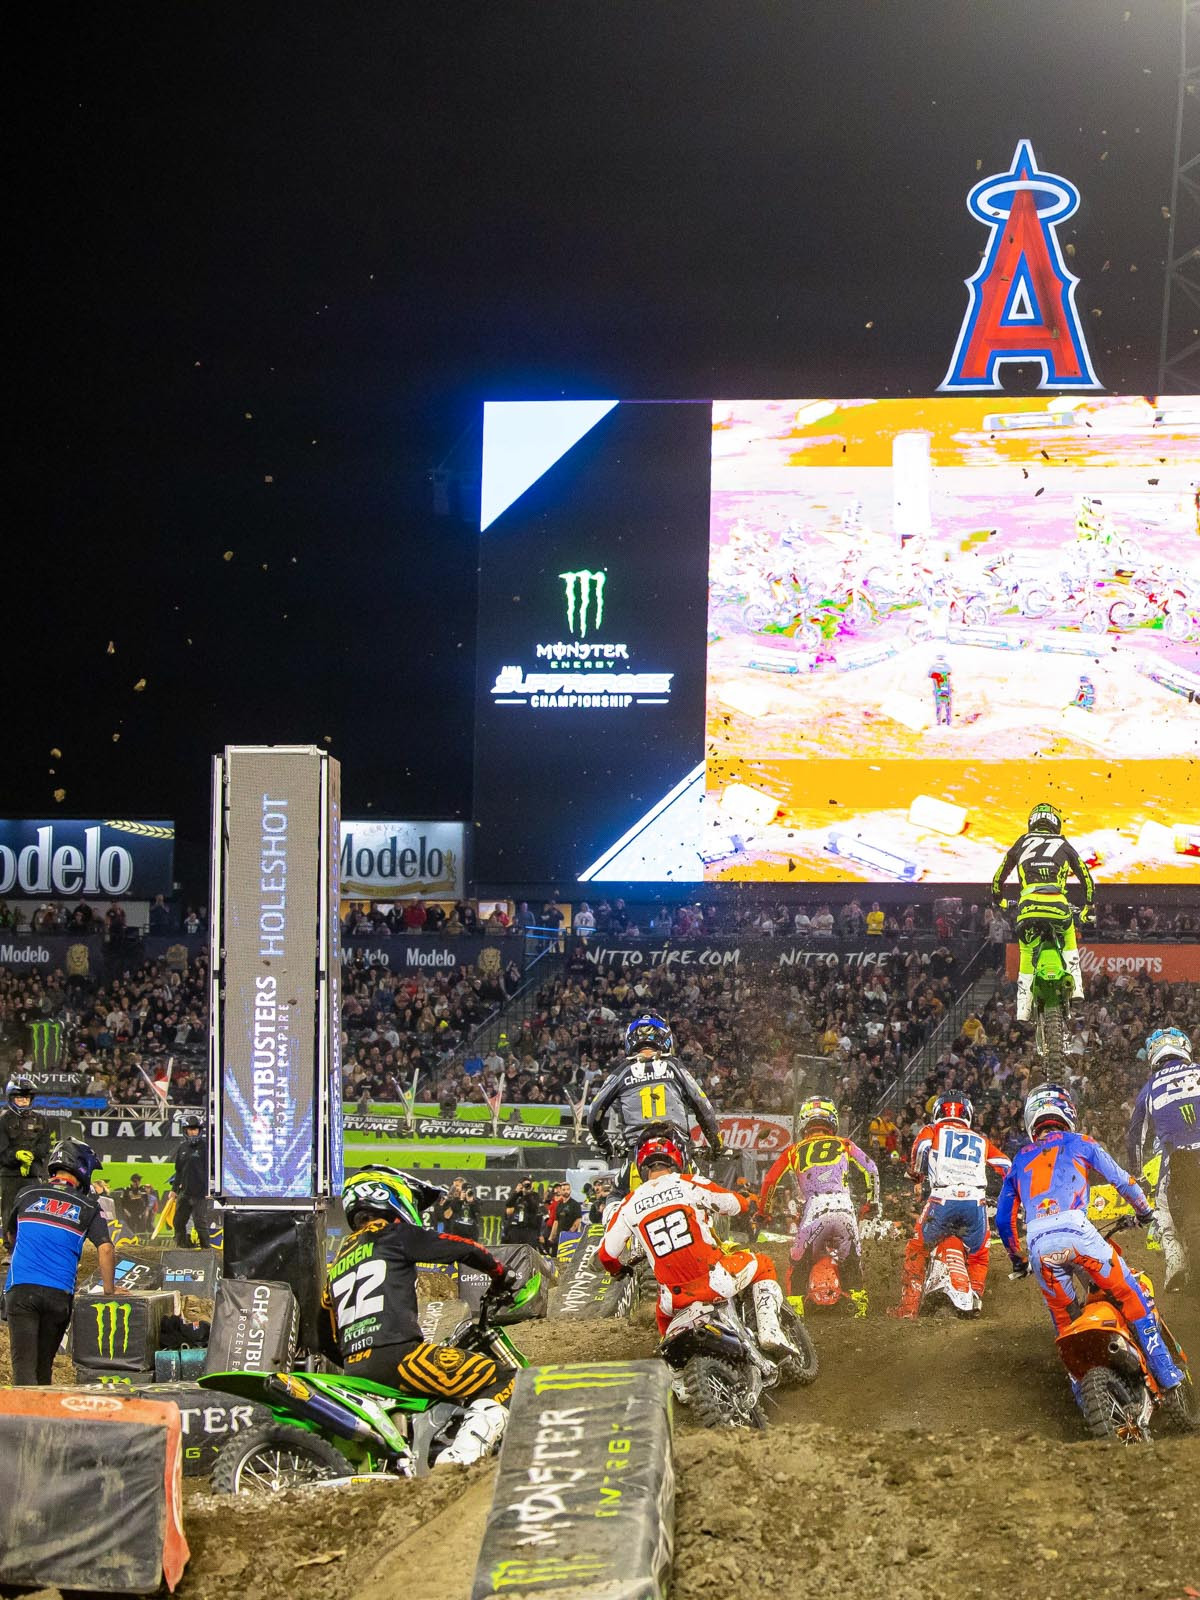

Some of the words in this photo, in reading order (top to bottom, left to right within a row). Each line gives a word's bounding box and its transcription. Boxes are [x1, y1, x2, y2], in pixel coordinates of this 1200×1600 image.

[935, 138, 1106, 392] A
[536, 641, 629, 660] MONSTER
[550, 661, 615, 669] ENERGY
[530, 695, 633, 708] CHAMPIONSHIP
[0, 825, 134, 895] odelo
[259, 793, 289, 957] HOLESHOT
[1, 945, 50, 963] Modelo
[341, 947, 389, 967] Mdelo
[406, 947, 456, 967] Modelo
[586, 946, 643, 966] NITTO
[650, 947, 741, 967] TIRE.COM
[779, 949, 839, 967] NITTO
[845, 950, 890, 967] TIRE
[1107, 956, 1162, 974] SPORTS
[10, 1071, 83, 1085] MONSTER
[624, 1068, 675, 1086] CHISHOLM
[639, 1084, 667, 1120] 11
[365, 1116, 398, 1124] MOUNTAIN
[431, 1119, 451, 1127] ROCKY
[452, 1120, 485, 1129] MOUNTAIN
[534, 1126, 568, 1135] MOUNTAIN
[717, 1121, 780, 1150] alphs
[799, 1139, 845, 1172] 18
[944, 1130, 983, 1164] 125
[1024, 1145, 1060, 1199] 1
[25, 1197, 82, 1221] AMA
[634, 1187, 684, 1214] DRAKE
[645, 1209, 693, 1258] 52
[122, 1264, 151, 1292] GoP
[165, 1268, 205, 1276] GoPro
[460, 1272, 523, 1284] GHOSTRS
[332, 1259, 387, 1330] 22
[234, 1307, 248, 1356] FROZEN
[243, 1285, 271, 1373] GHOSTBU
[506, 1405, 594, 1546] MONSTER
